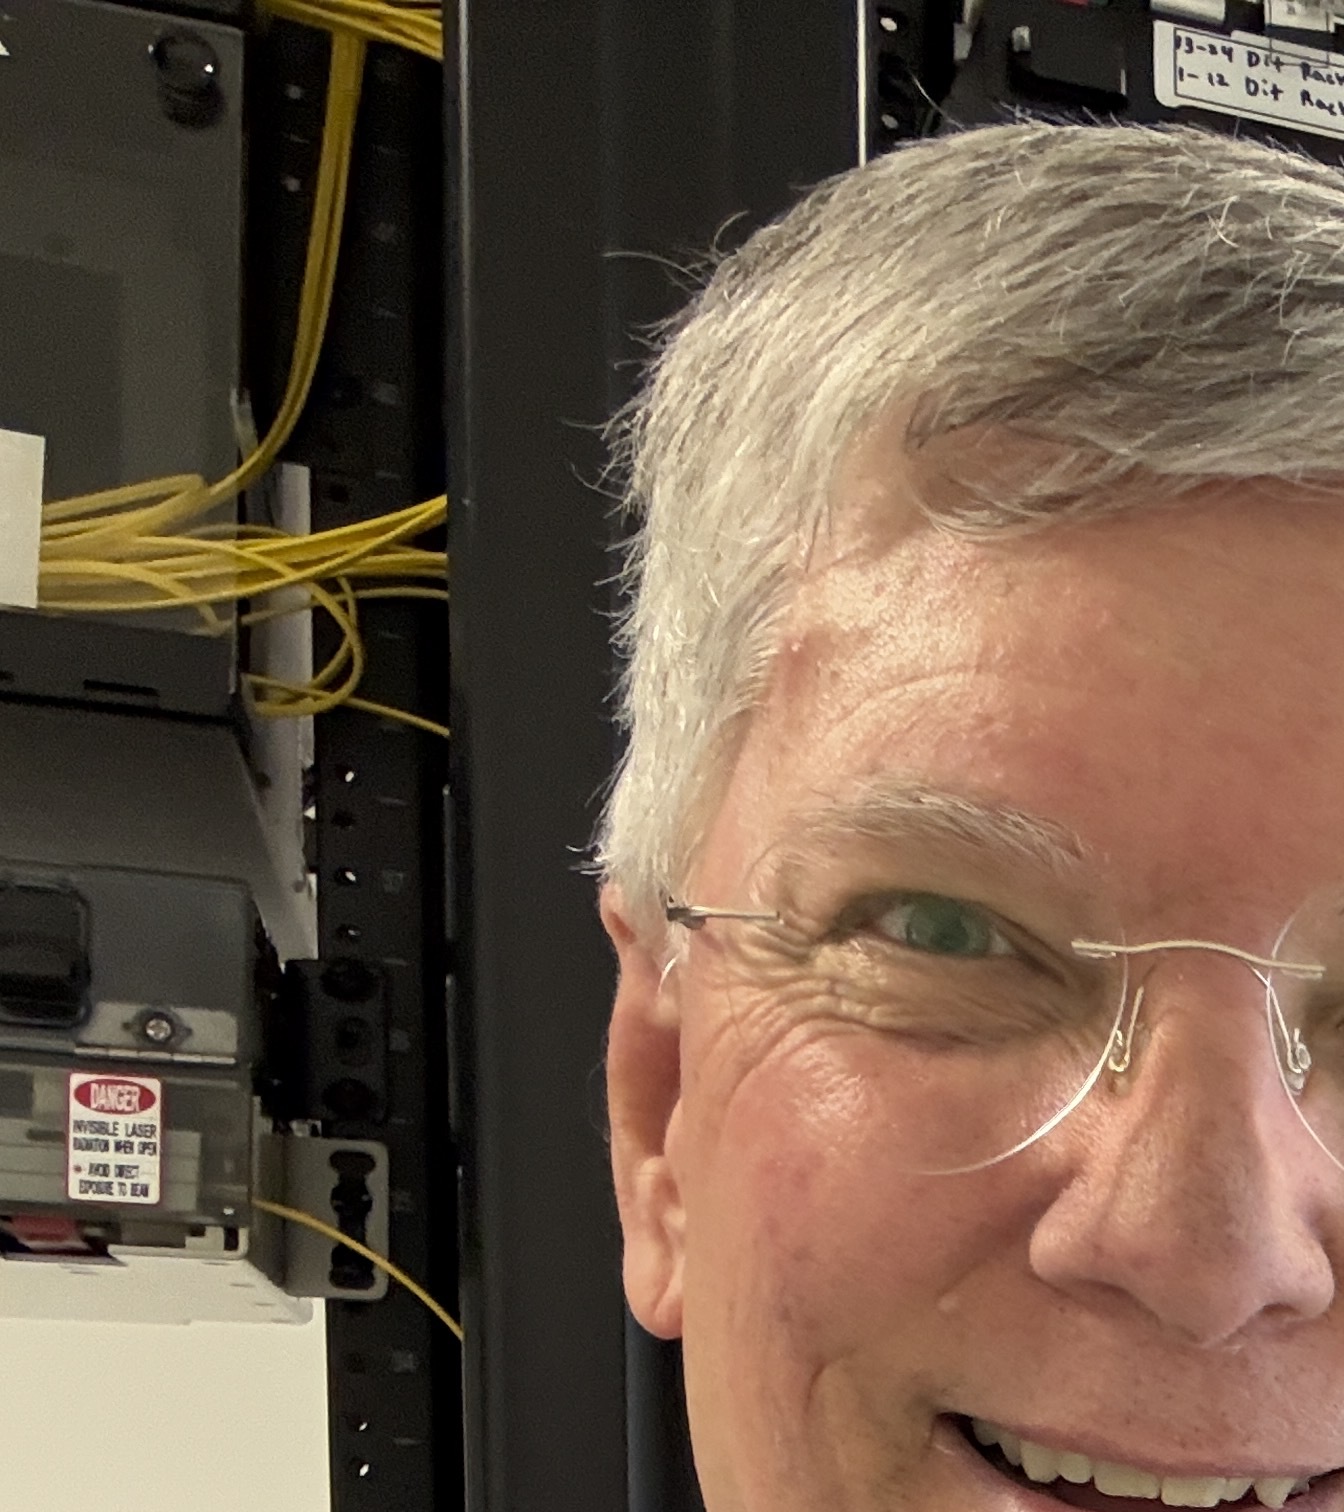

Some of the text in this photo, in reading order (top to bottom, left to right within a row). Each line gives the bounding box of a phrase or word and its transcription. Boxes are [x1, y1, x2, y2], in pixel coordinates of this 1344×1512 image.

[90, 1082, 140, 1113] DANGER
[73, 1119, 157, 1139] INVISIBLE LASER
